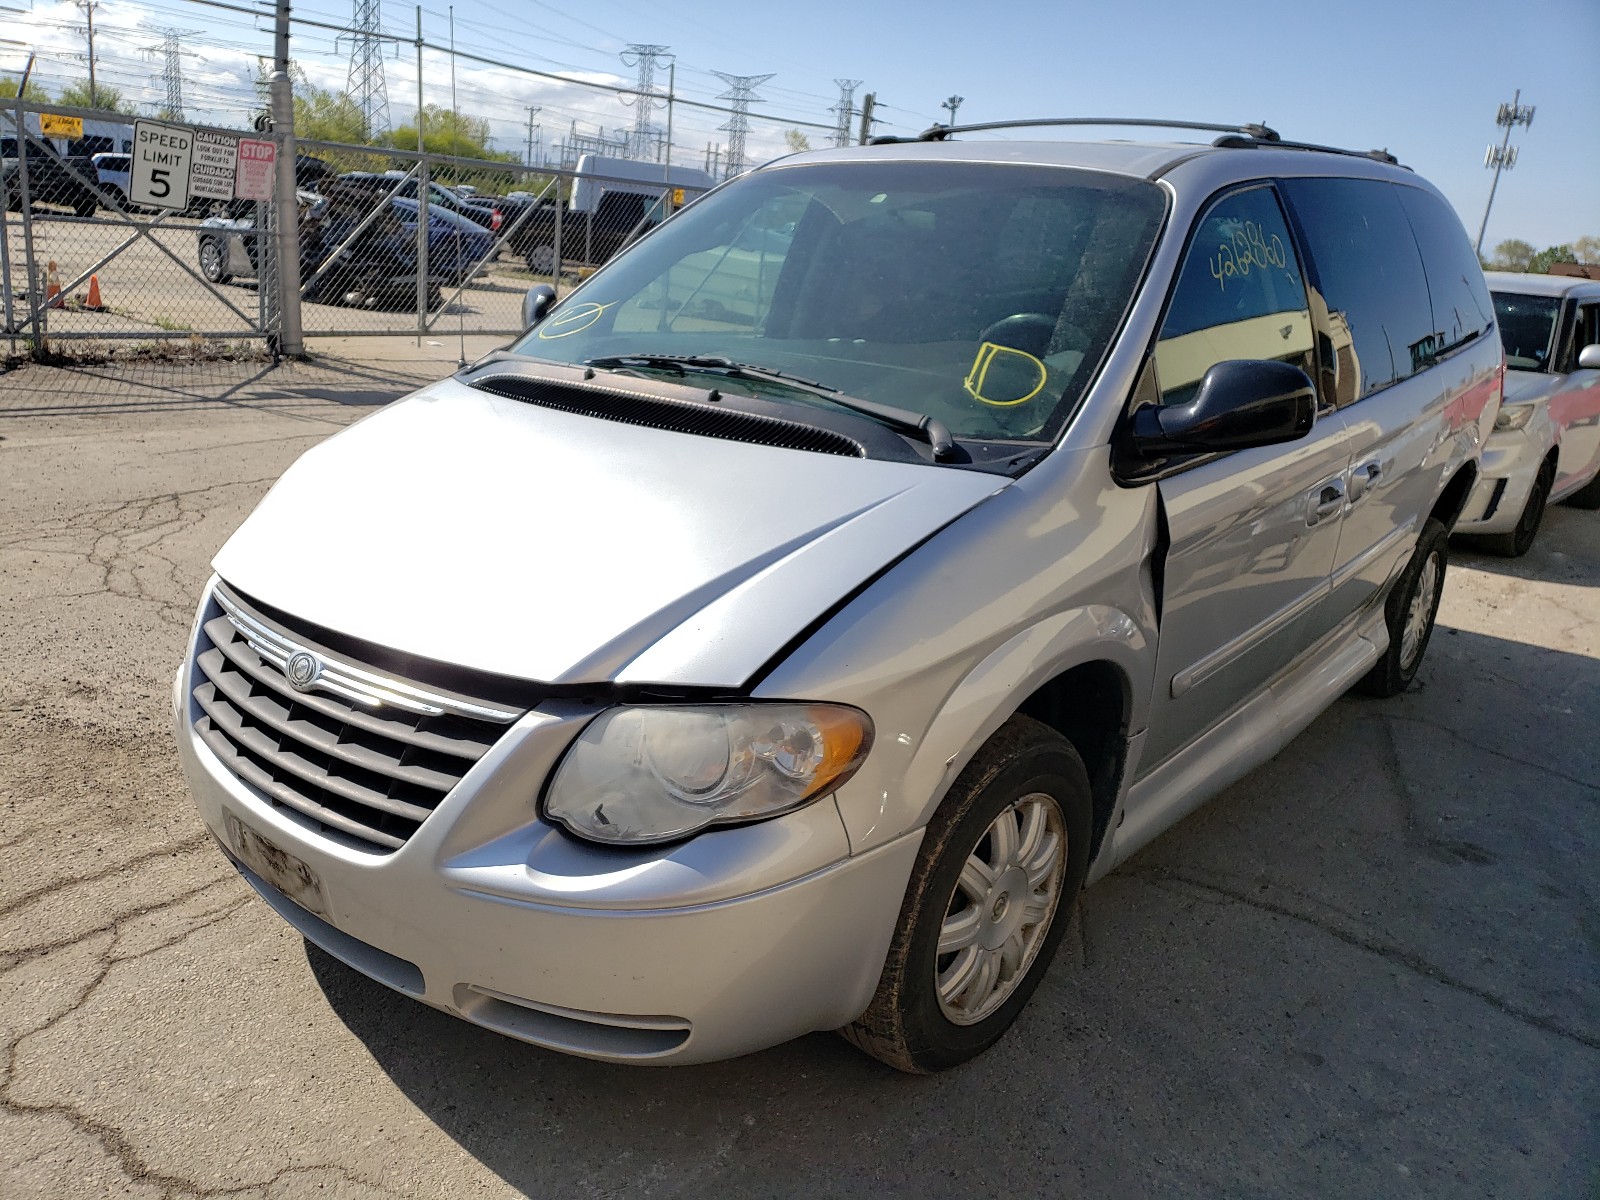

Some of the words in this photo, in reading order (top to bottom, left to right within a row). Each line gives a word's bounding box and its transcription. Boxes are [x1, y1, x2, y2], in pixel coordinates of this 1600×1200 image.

[139, 130, 188, 150] SPEED
[196, 131, 237, 147] CAUTION
[143, 149, 182, 167] LIMIT
[196, 143, 211, 153] LOOK
[212, 146, 223, 155] OUT
[224, 149, 235, 157] FOR
[242, 143, 273, 160] STOP
[200, 154, 230, 165] FORKLIFTS
[193, 164, 234, 178] CUIDADO
[149, 168, 171, 198] 5
